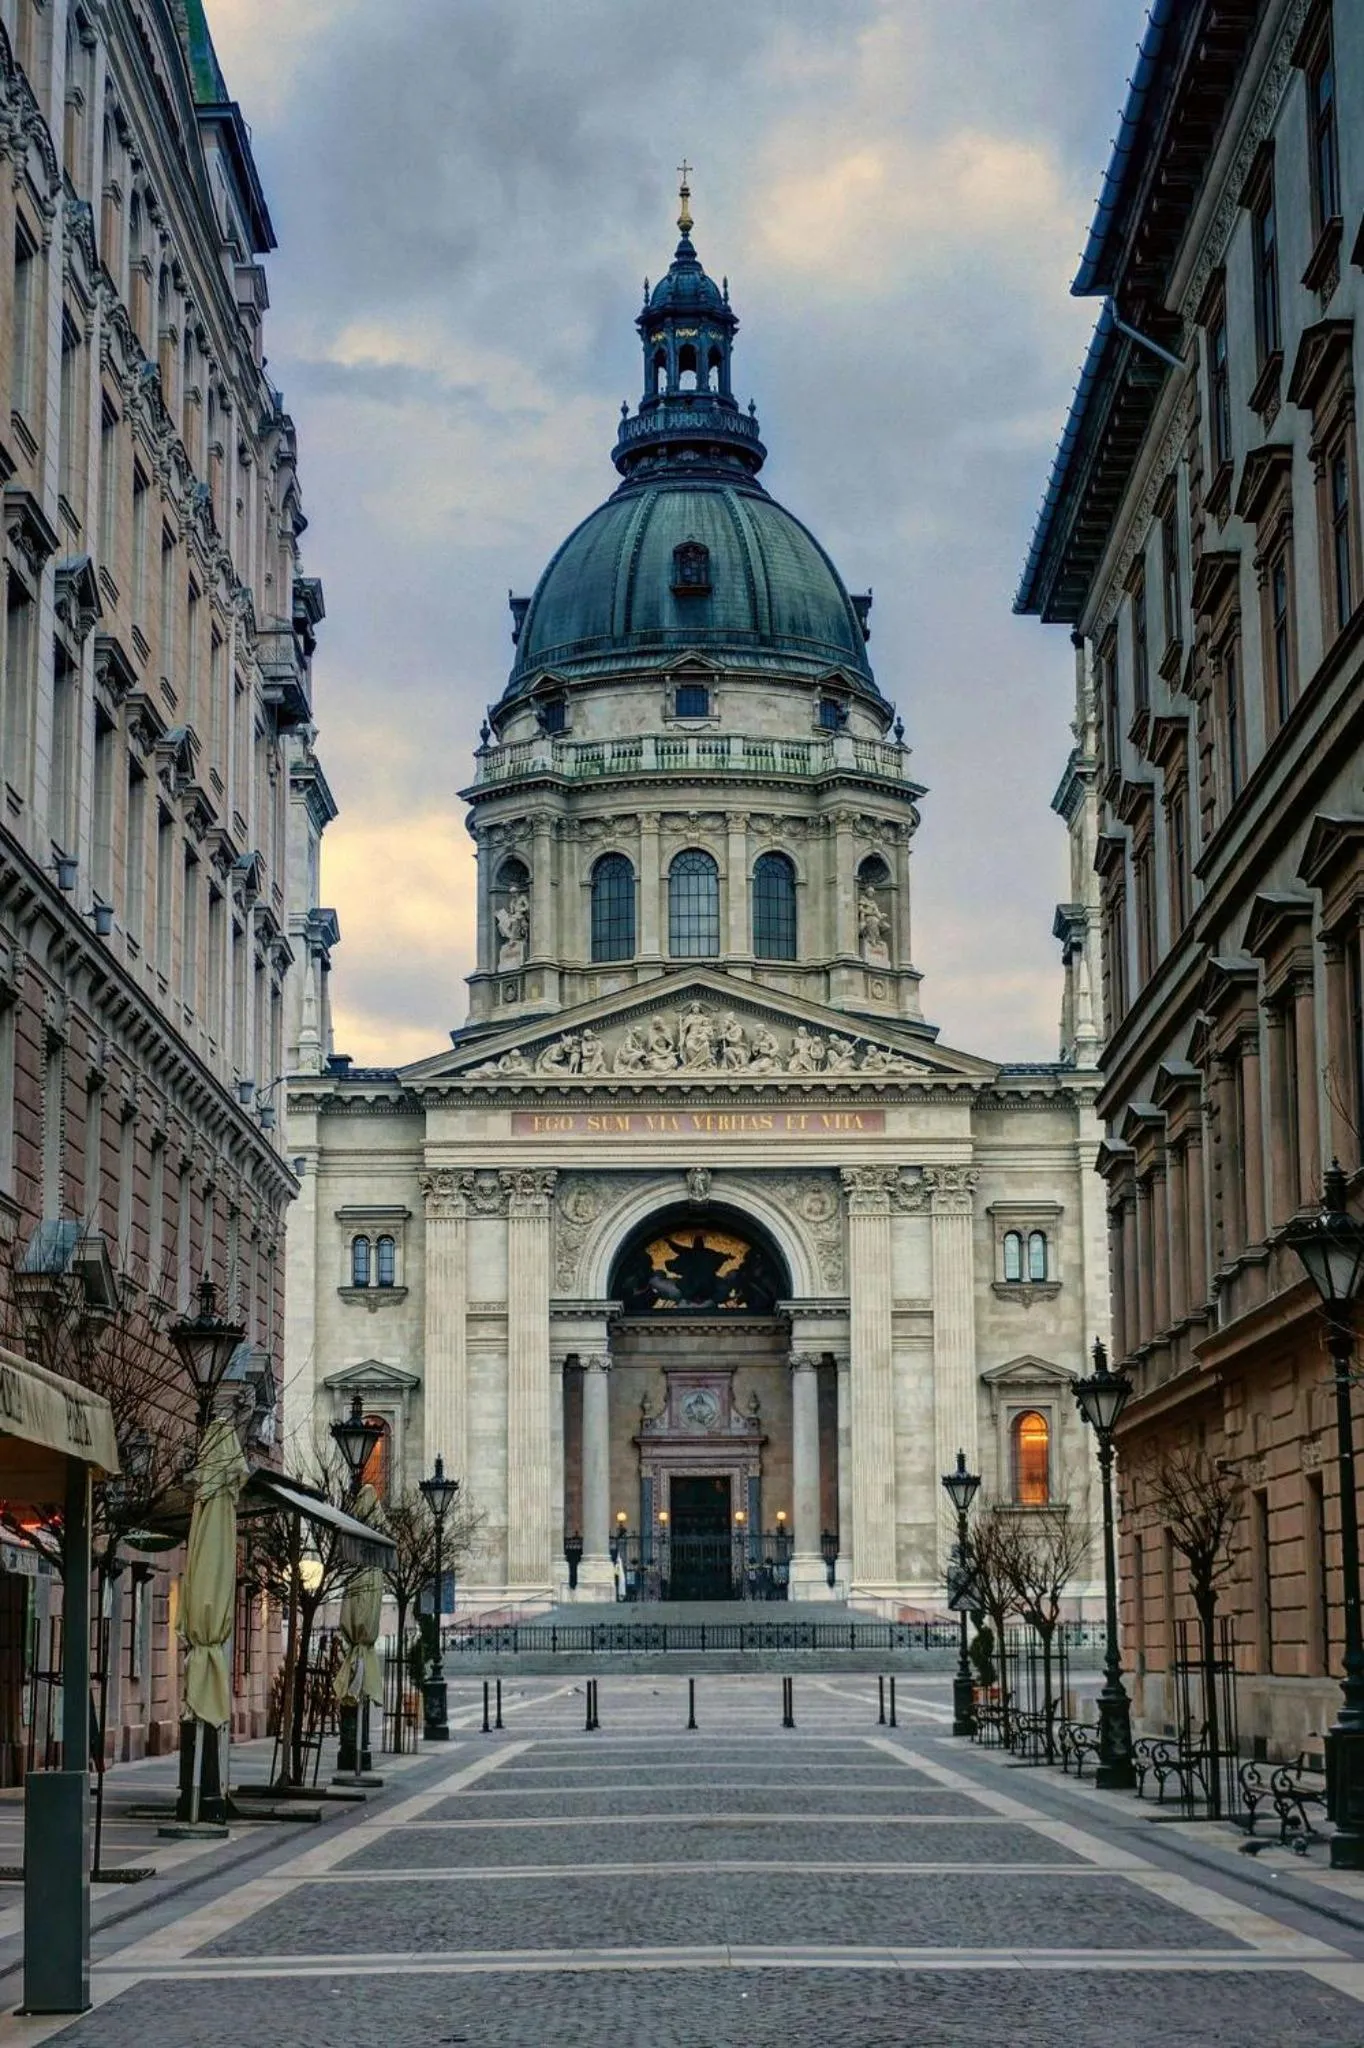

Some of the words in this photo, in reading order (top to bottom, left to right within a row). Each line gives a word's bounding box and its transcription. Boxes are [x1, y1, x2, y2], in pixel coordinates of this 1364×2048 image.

[533, 1115, 573, 1131] EGO
[587, 1115, 631, 1131] SUM
[645, 1115, 680, 1131] VIA
[691, 1114, 775, 1130] VERITAS
[786, 1114, 809, 1130] ET
[821, 1114, 864, 1129] VITA
